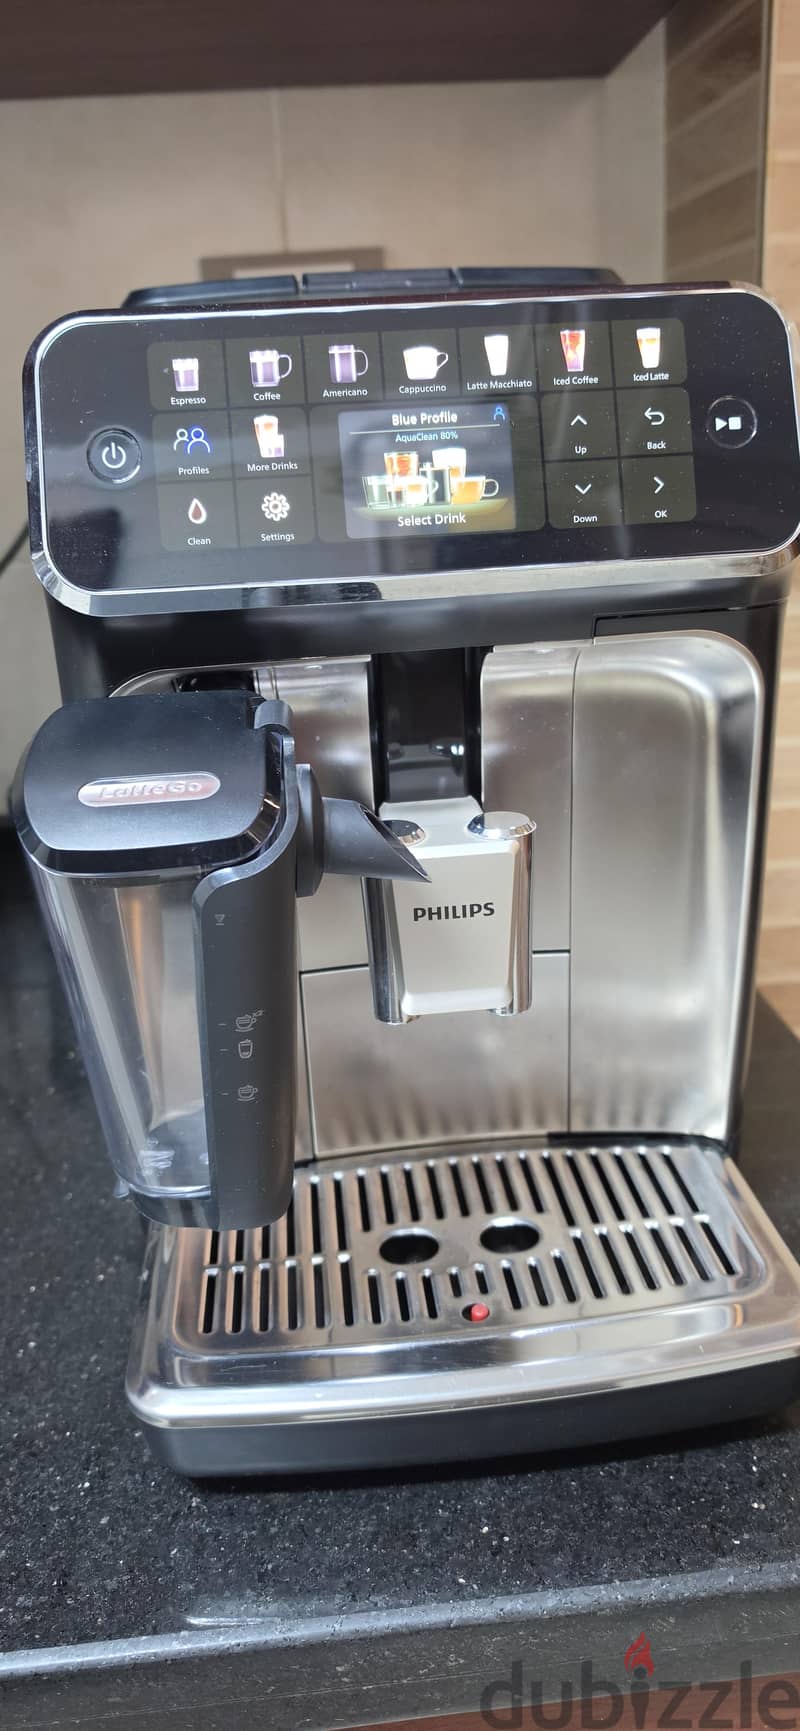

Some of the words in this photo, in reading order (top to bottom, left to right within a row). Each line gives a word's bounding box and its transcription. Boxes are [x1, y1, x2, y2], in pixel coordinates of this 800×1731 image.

[553, 376, 570, 386] Iced
[572, 375, 599, 385] Coffee
[633, 372, 649, 381] Iced
[650, 371, 669, 381] Latte
[399, 384, 447, 394] Cappuccino
[467, 380, 488, 390] Latte
[489, 378, 532, 389] Macchiato
[253, 391, 281, 401] Coffee
[322, 388, 368, 398] Americano
[170, 396, 206, 406] Espresso
[391, 413, 418, 426] Blue
[420, 411, 458, 424] Profile
[395, 432, 438, 443] AquaClean
[440, 430, 458, 441] 80%
[575, 445, 587, 455] Up
[647, 440, 666, 450] Back
[178, 466, 210, 476] Profiles
[247, 462, 269, 472] More
[271, 461, 298, 471] Drinks
[573, 514, 598, 524] Down
[654, 509, 667, 519] OK
[397, 514, 432, 527] Select
[435, 512, 466, 525] Drink
[187, 536, 211, 545] Clean
[260, 532, 295, 543] Settings
[413, 902, 495, 922] PHILIPS
